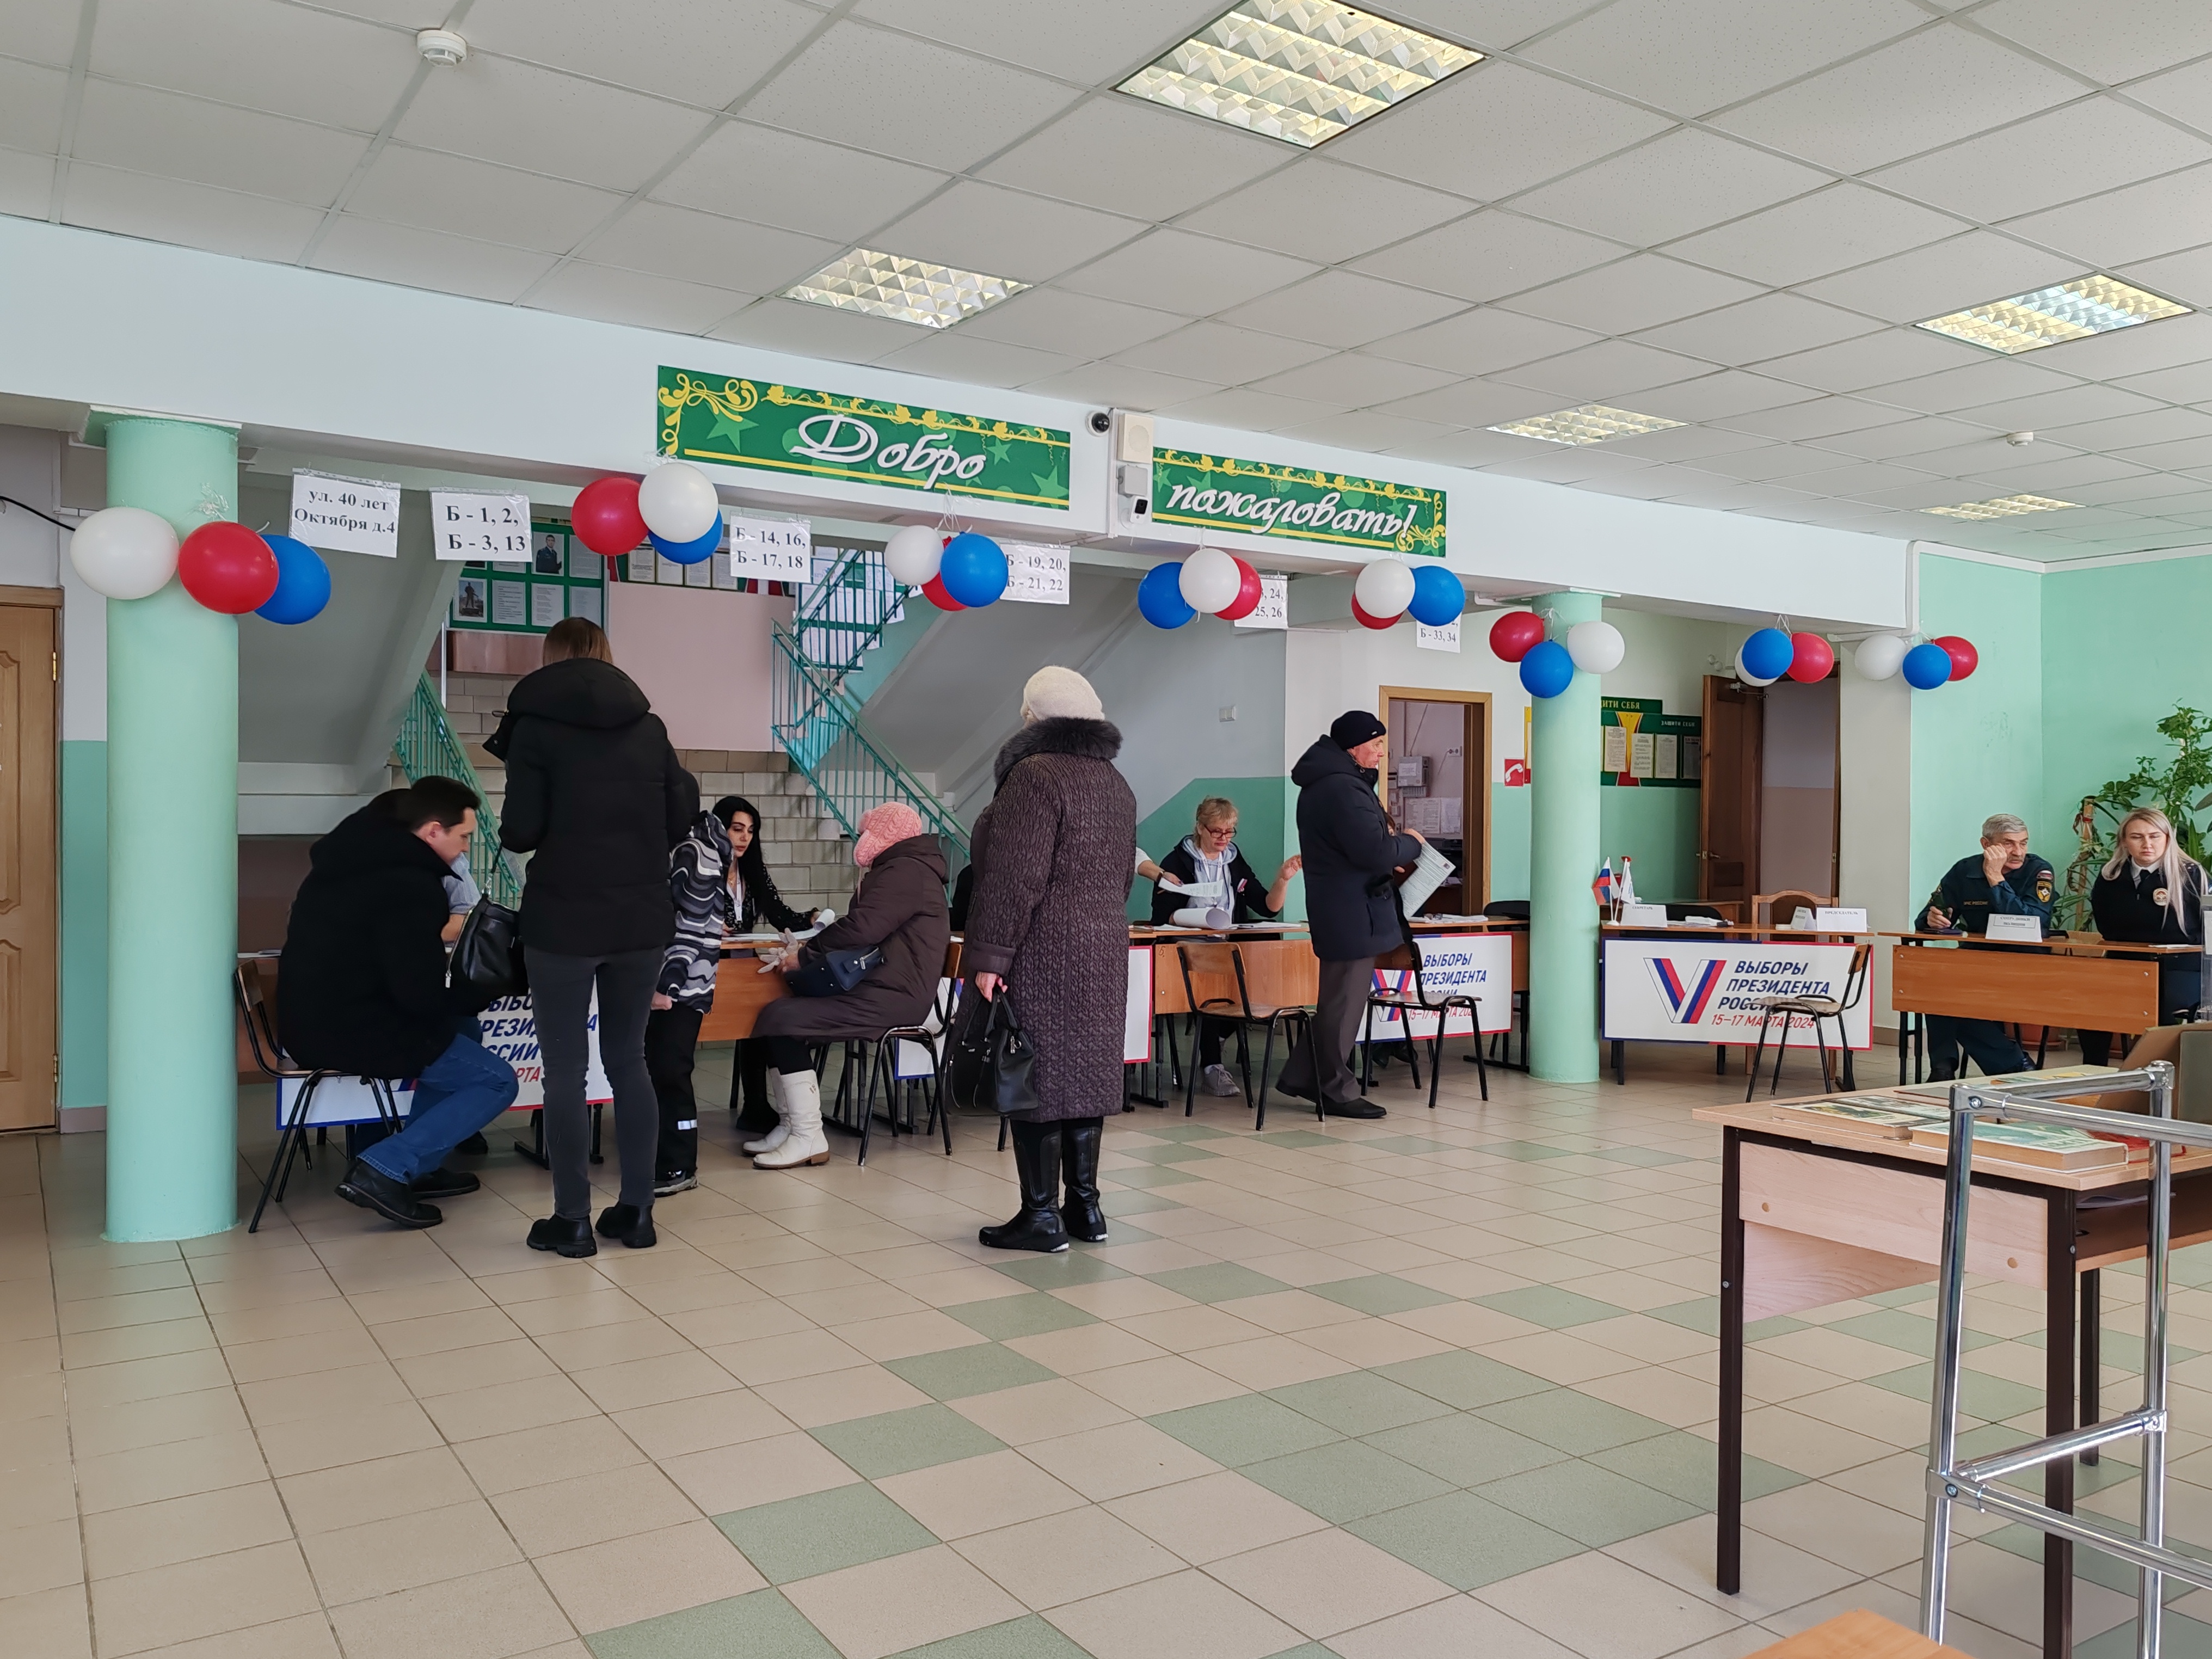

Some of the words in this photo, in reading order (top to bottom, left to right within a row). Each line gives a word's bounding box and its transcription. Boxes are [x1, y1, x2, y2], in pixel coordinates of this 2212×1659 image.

[789, 414, 986, 490] Добро
[309, 490, 333, 503] ул.
[338, 493, 357, 506] 40
[361, 499, 389, 511] лет
[445, 505, 460, 521] Б
[481, 507, 496, 526] 1,
[502, 508, 518, 527] 2,
[1166, 484, 1417, 538] пожаловать!
[294, 508, 367, 531] Октября
[372, 521, 395, 533] д.4
[447, 534, 462, 549] Б
[482, 535, 499, 554] 3,
[505, 536, 525, 551] 13
[735, 527, 746, 540] Б
[761, 531, 781, 547] 14,
[786, 533, 806, 549] 16,
[736, 550, 747, 563] Б
[763, 554, 782, 570] 17,
[788, 555, 803, 569] 18
[1028, 556, 1044, 570] 19,
[1048, 557, 1066, 573] 20,
[1028, 577, 1046, 592] 21,
[1049, 579, 1063, 591] 22
[1270, 588, 1284, 602] 24,
[1255, 606, 1268, 619] 25,
[1271, 607, 1282, 618] 26
[1420, 627, 1426, 638] Б
[1447, 632, 1457, 642] 34
[1601, 700, 1618, 708] ИТИ
[1621, 701, 1640, 709] СЕБЯ
[1423, 953, 1473, 967] ВЫБОРЫ
[1735, 961, 1809, 975] ВЫБОРЫ
[1420, 970, 1487, 986] ПРЕЗИДЕНТА
[1726, 979, 1830, 995] ПРЕЗИДЕНТА
[1458, 1006, 1472, 1017] 202
[1787, 1016, 1815, 1029] 2024
